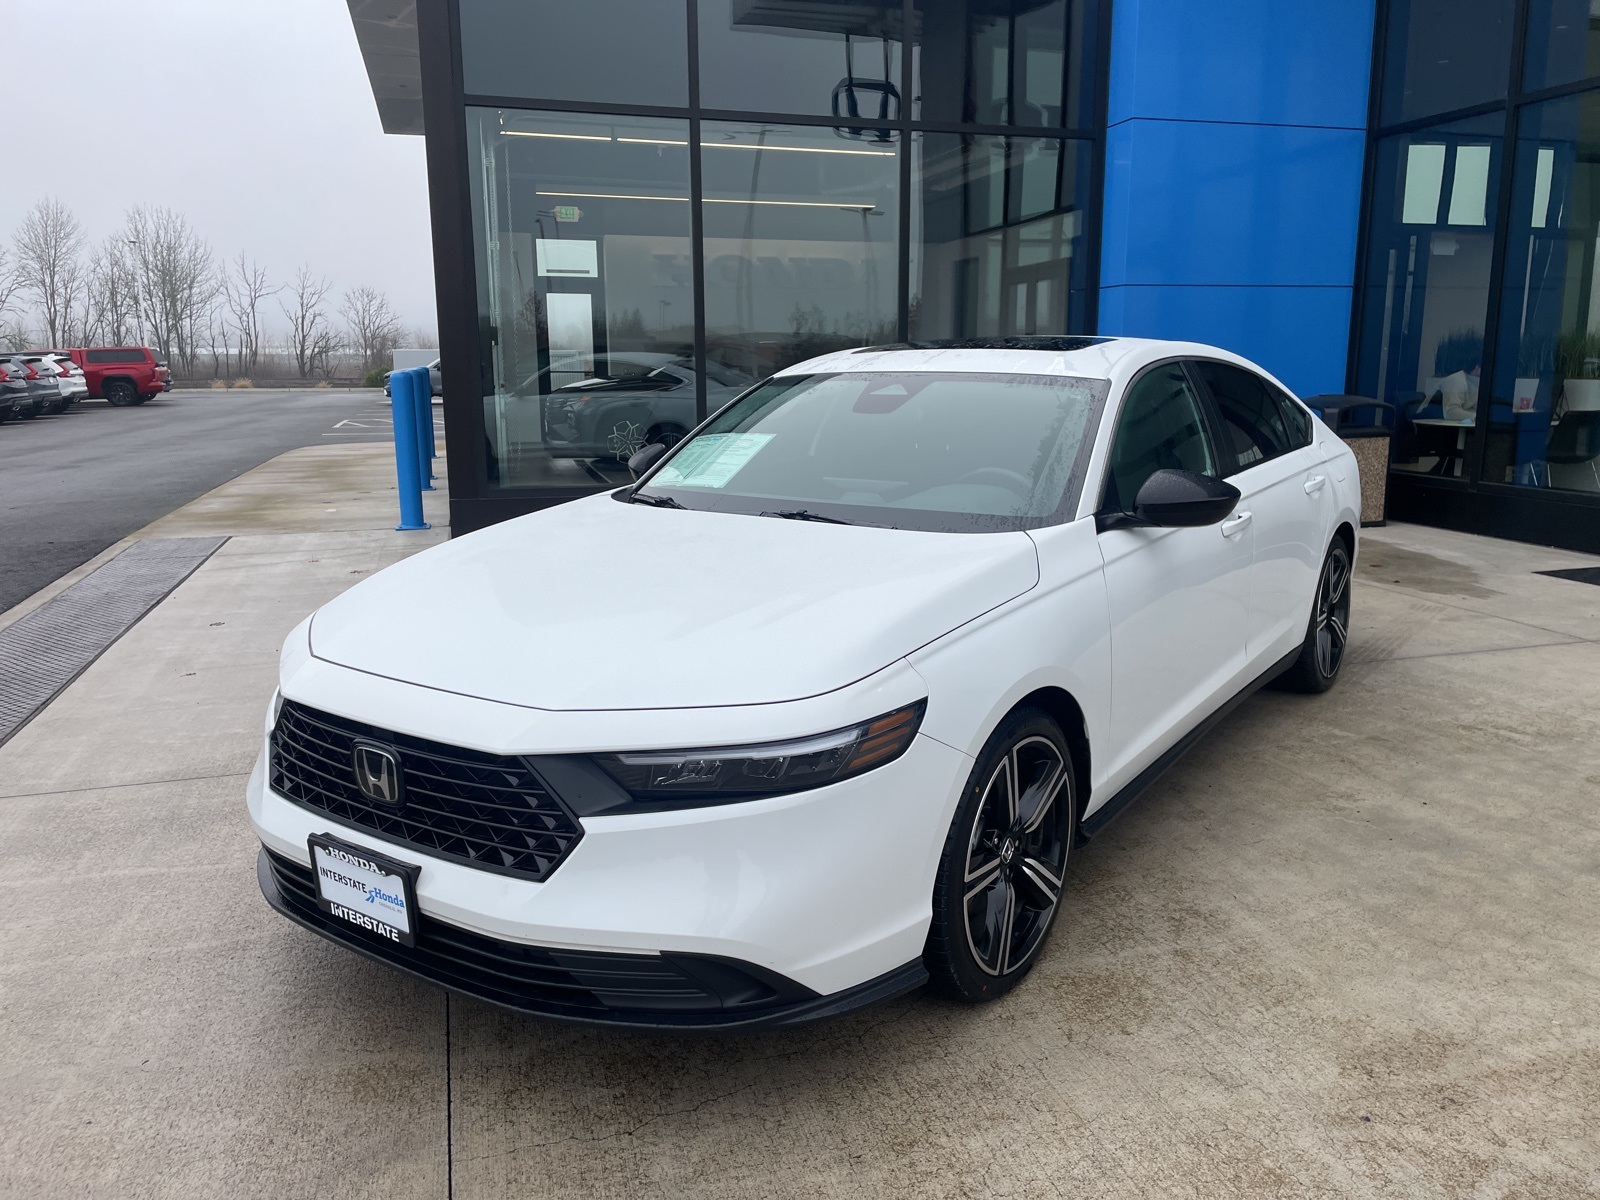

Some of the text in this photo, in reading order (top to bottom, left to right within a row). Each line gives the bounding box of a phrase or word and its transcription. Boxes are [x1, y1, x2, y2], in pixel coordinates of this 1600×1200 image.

[560, 207, 575, 220] EXIT
[328, 847, 381, 875] HONDA
[320, 867, 368, 893] INTERSTATE
[373, 887, 405, 908] Honda
[331, 902, 400, 942] INTERSTATE
